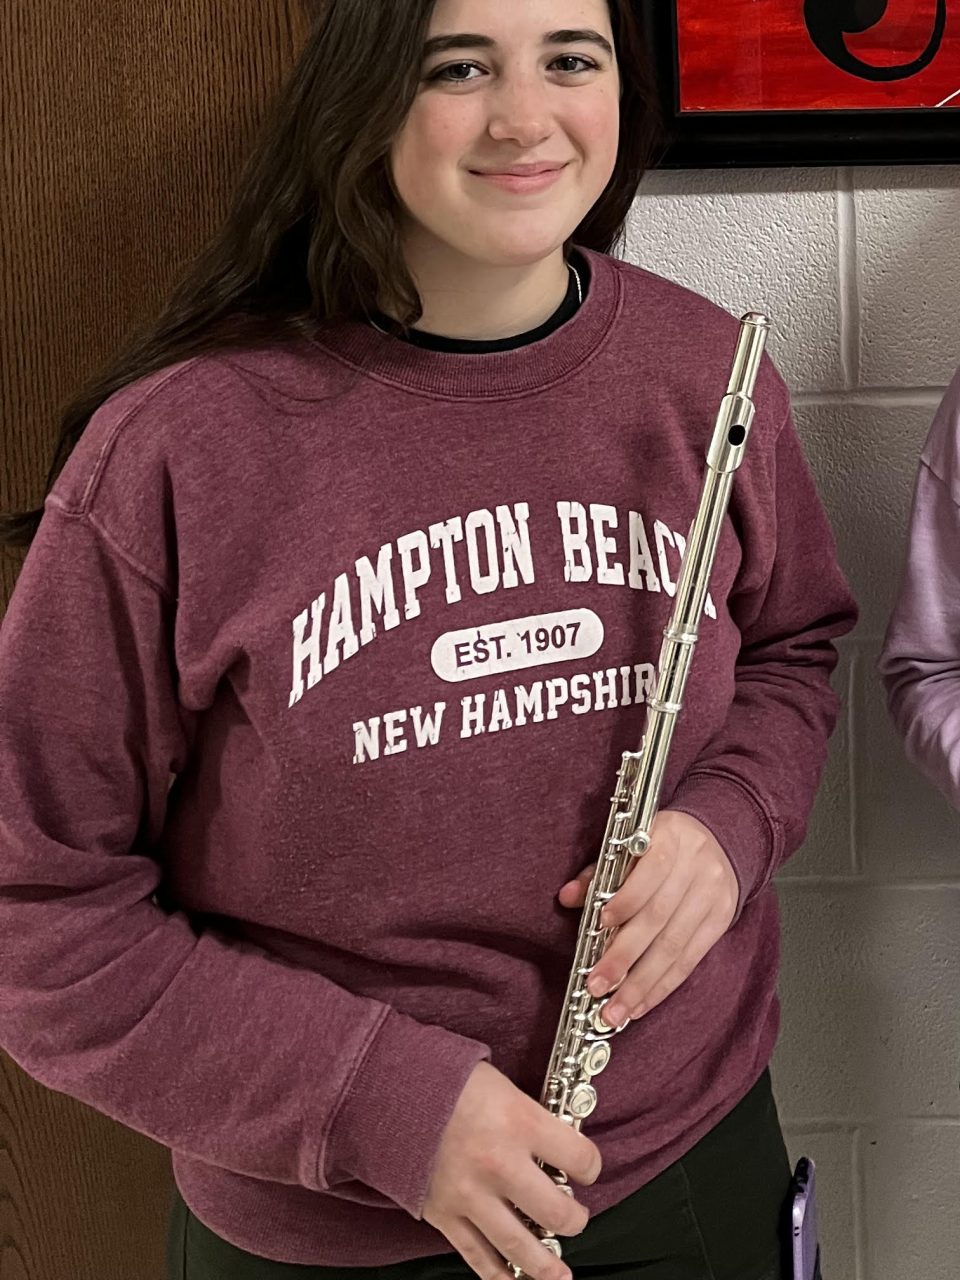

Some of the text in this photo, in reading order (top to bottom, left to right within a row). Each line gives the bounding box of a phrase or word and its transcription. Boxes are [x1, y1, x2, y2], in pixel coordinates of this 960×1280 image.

[287, 500, 718, 709] HAMPTON BEAC
[454, 621, 582, 668] EST. 1907
[352, 662, 660, 765] NEW HAMPSHIR
